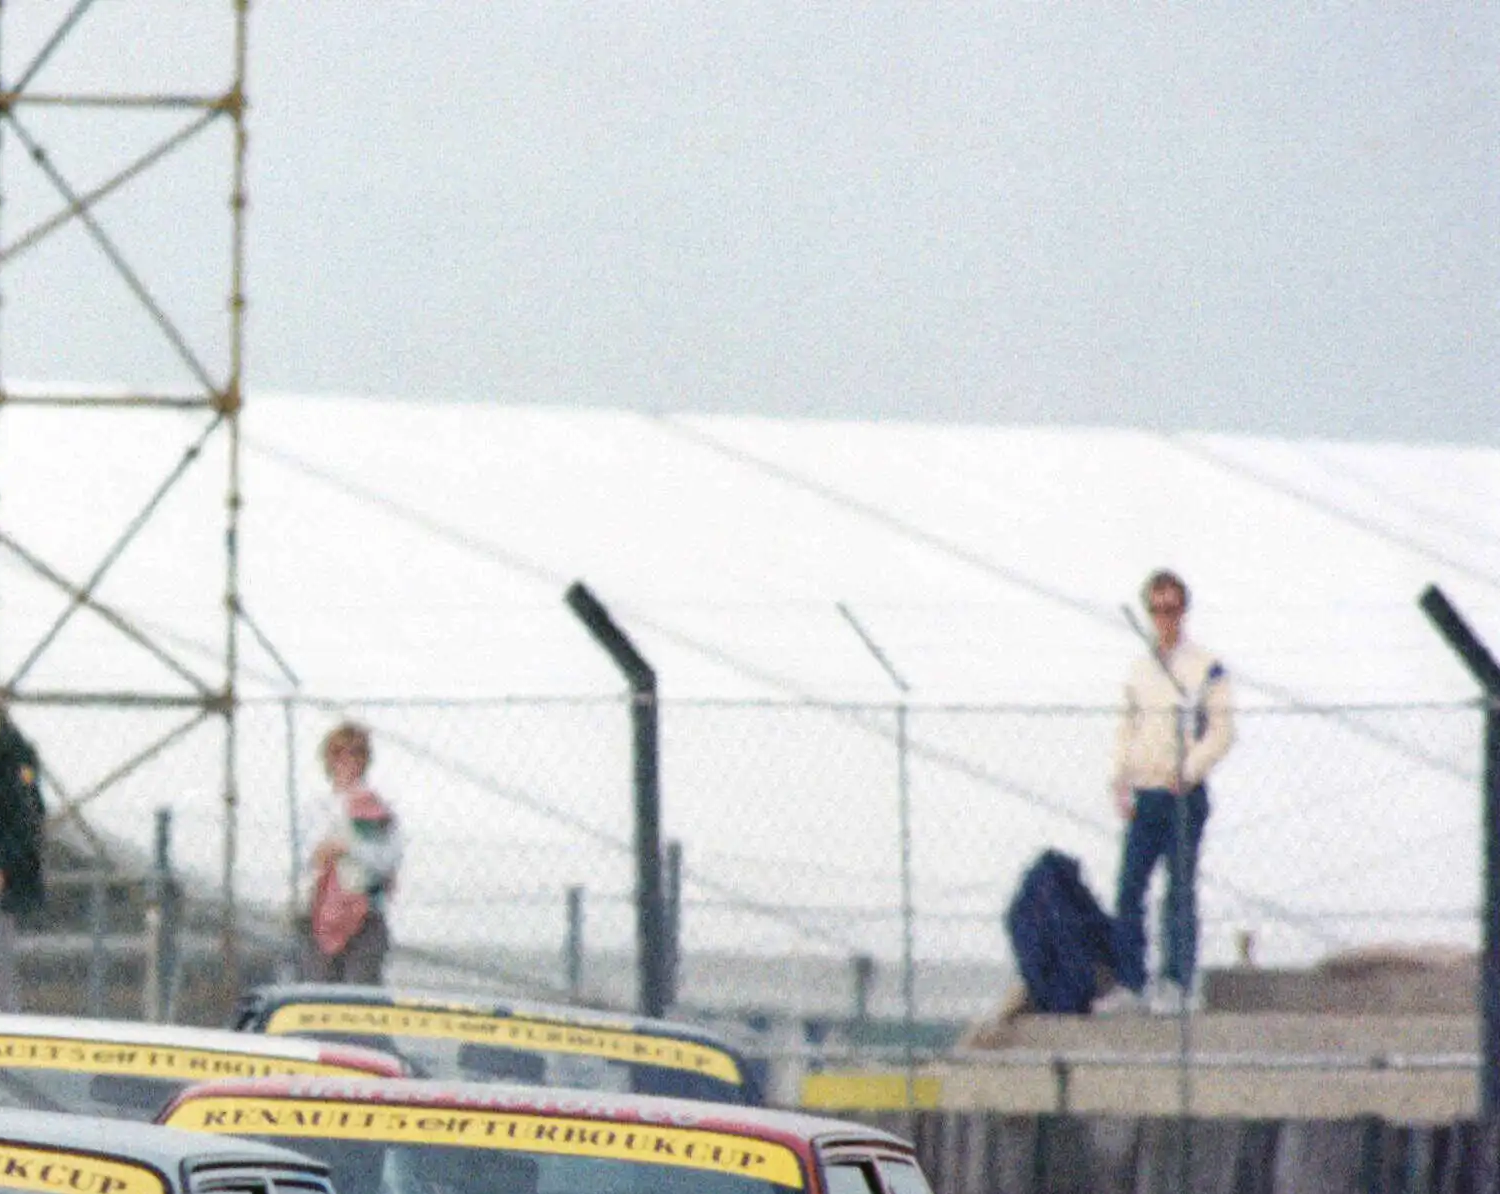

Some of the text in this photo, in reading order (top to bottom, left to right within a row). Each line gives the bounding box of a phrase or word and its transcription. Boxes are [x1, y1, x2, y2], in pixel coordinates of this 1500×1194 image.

[91, 1050, 138, 1065] elf
[203, 1108, 767, 1169] RENAULT 5 elf TURBO UK CUP
